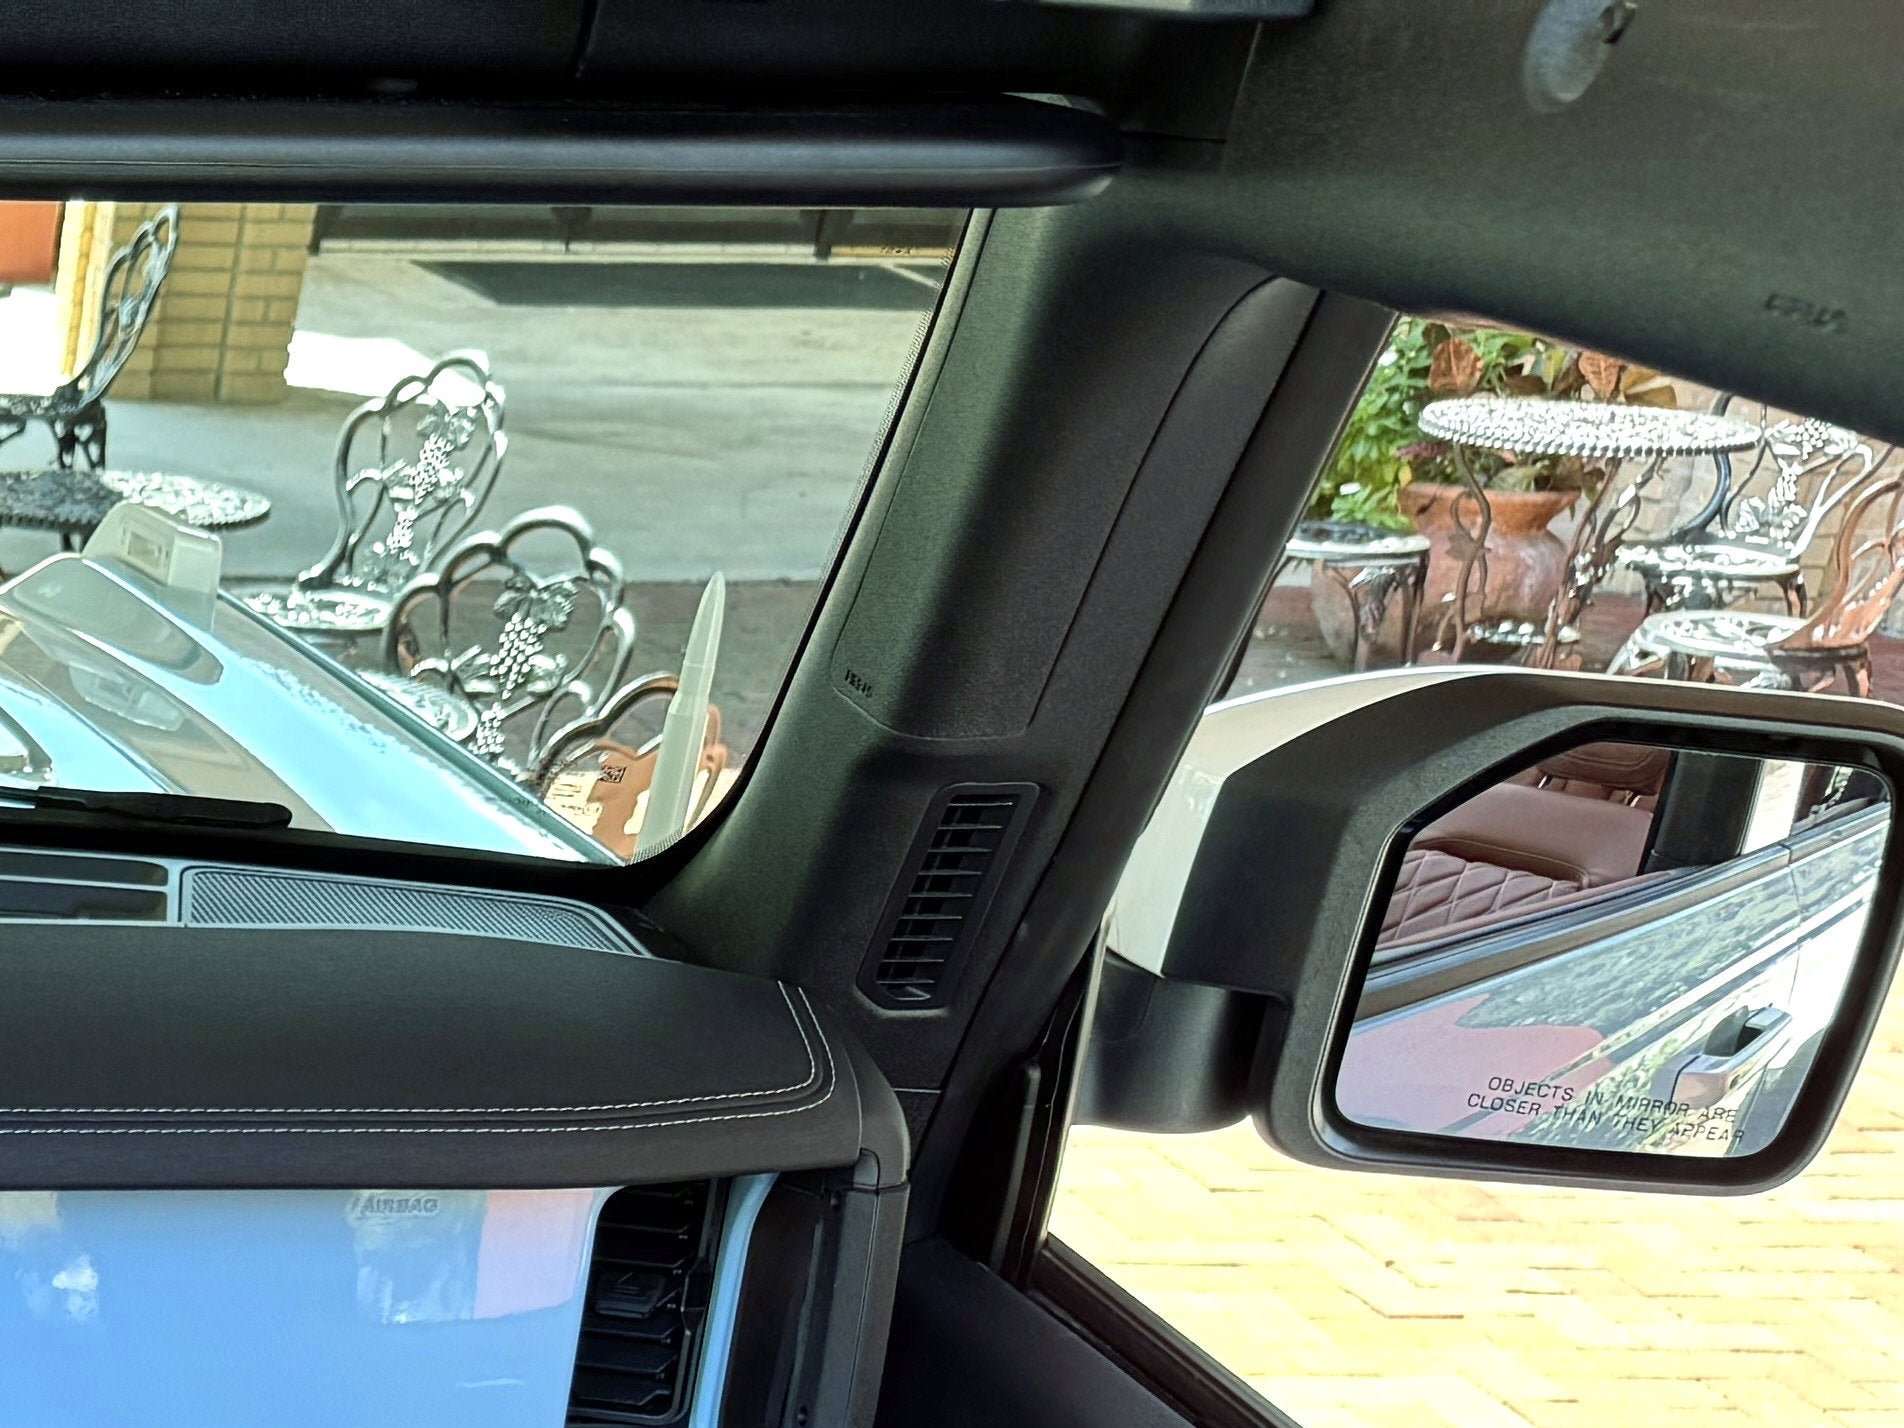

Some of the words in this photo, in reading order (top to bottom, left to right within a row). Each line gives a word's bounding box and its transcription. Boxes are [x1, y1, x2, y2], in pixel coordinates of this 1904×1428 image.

[1467, 1093, 1542, 1116] CLOSER
[1553, 1103, 1603, 1126] THAN
[1613, 1112, 1663, 1131] THEY
[1669, 1122, 1745, 1141] APPEAR
[1488, 1076, 1575, 1101] OBJECTS
[1584, 1083, 1604, 1106] IN
[1615, 1094, 1690, 1116] MIRROR
[1697, 1107, 1738, 1123] ARE
